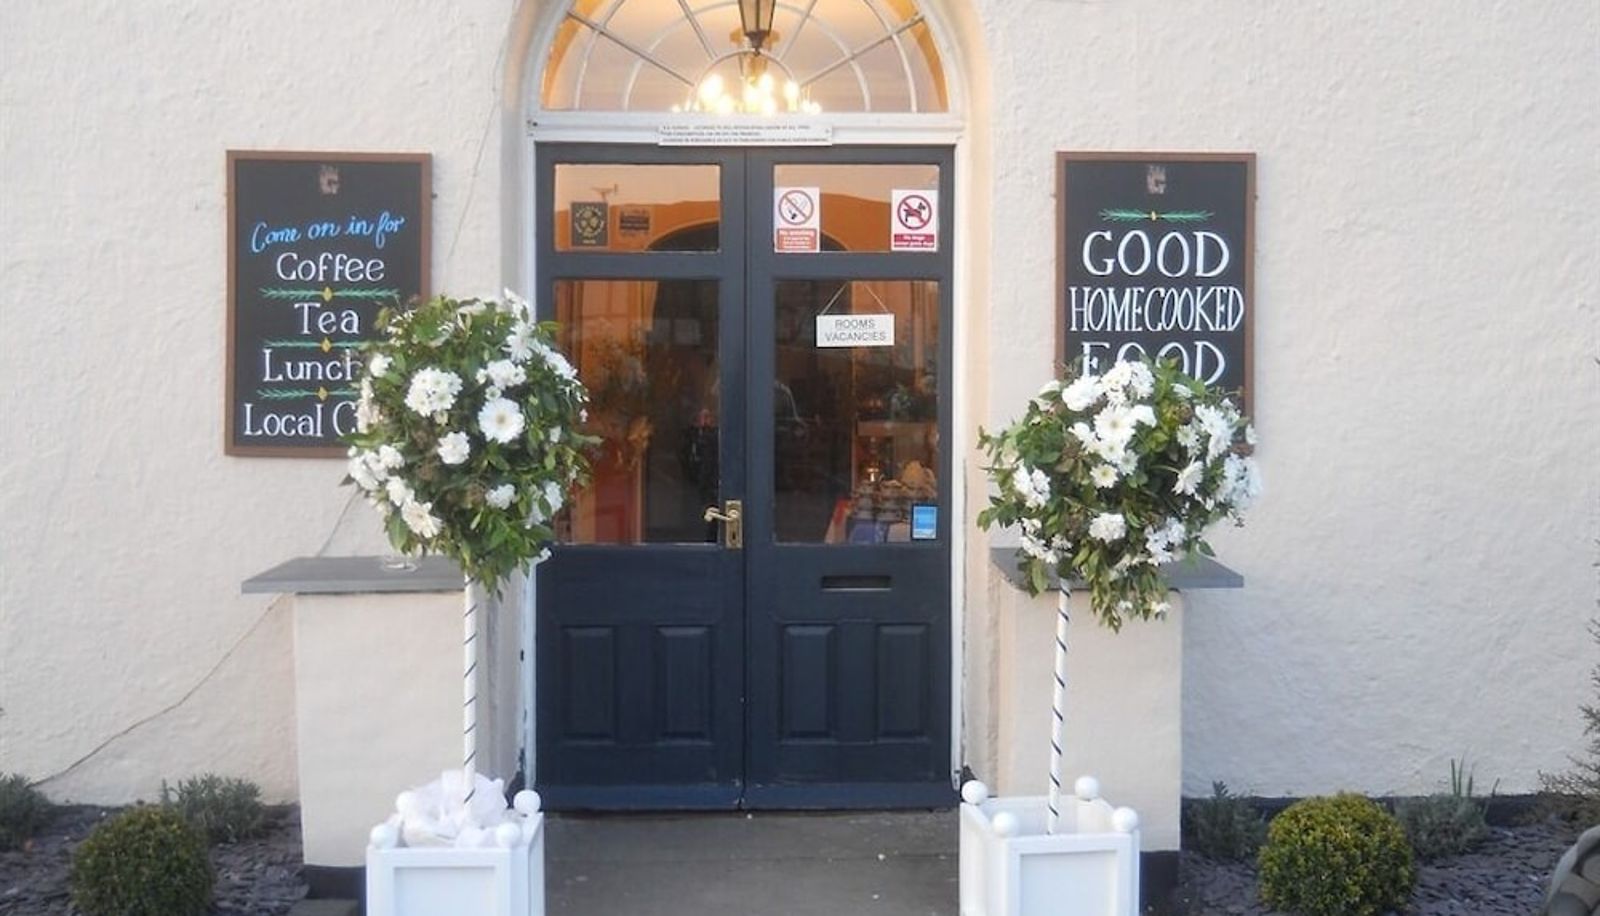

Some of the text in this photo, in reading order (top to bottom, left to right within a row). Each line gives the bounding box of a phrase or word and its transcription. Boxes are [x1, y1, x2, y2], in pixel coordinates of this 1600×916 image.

[252, 211, 405, 252] Come on in for
[276, 252, 385, 282] Coffee
[1082, 230, 1230, 277] GOOD
[294, 302, 360, 335] Tea
[835, 319, 876, 330] ROOMS
[1069, 286, 1244, 332] HOMECOOKED
[825, 332, 887, 342] VACANCIES
[244, 403, 323, 437] Local
